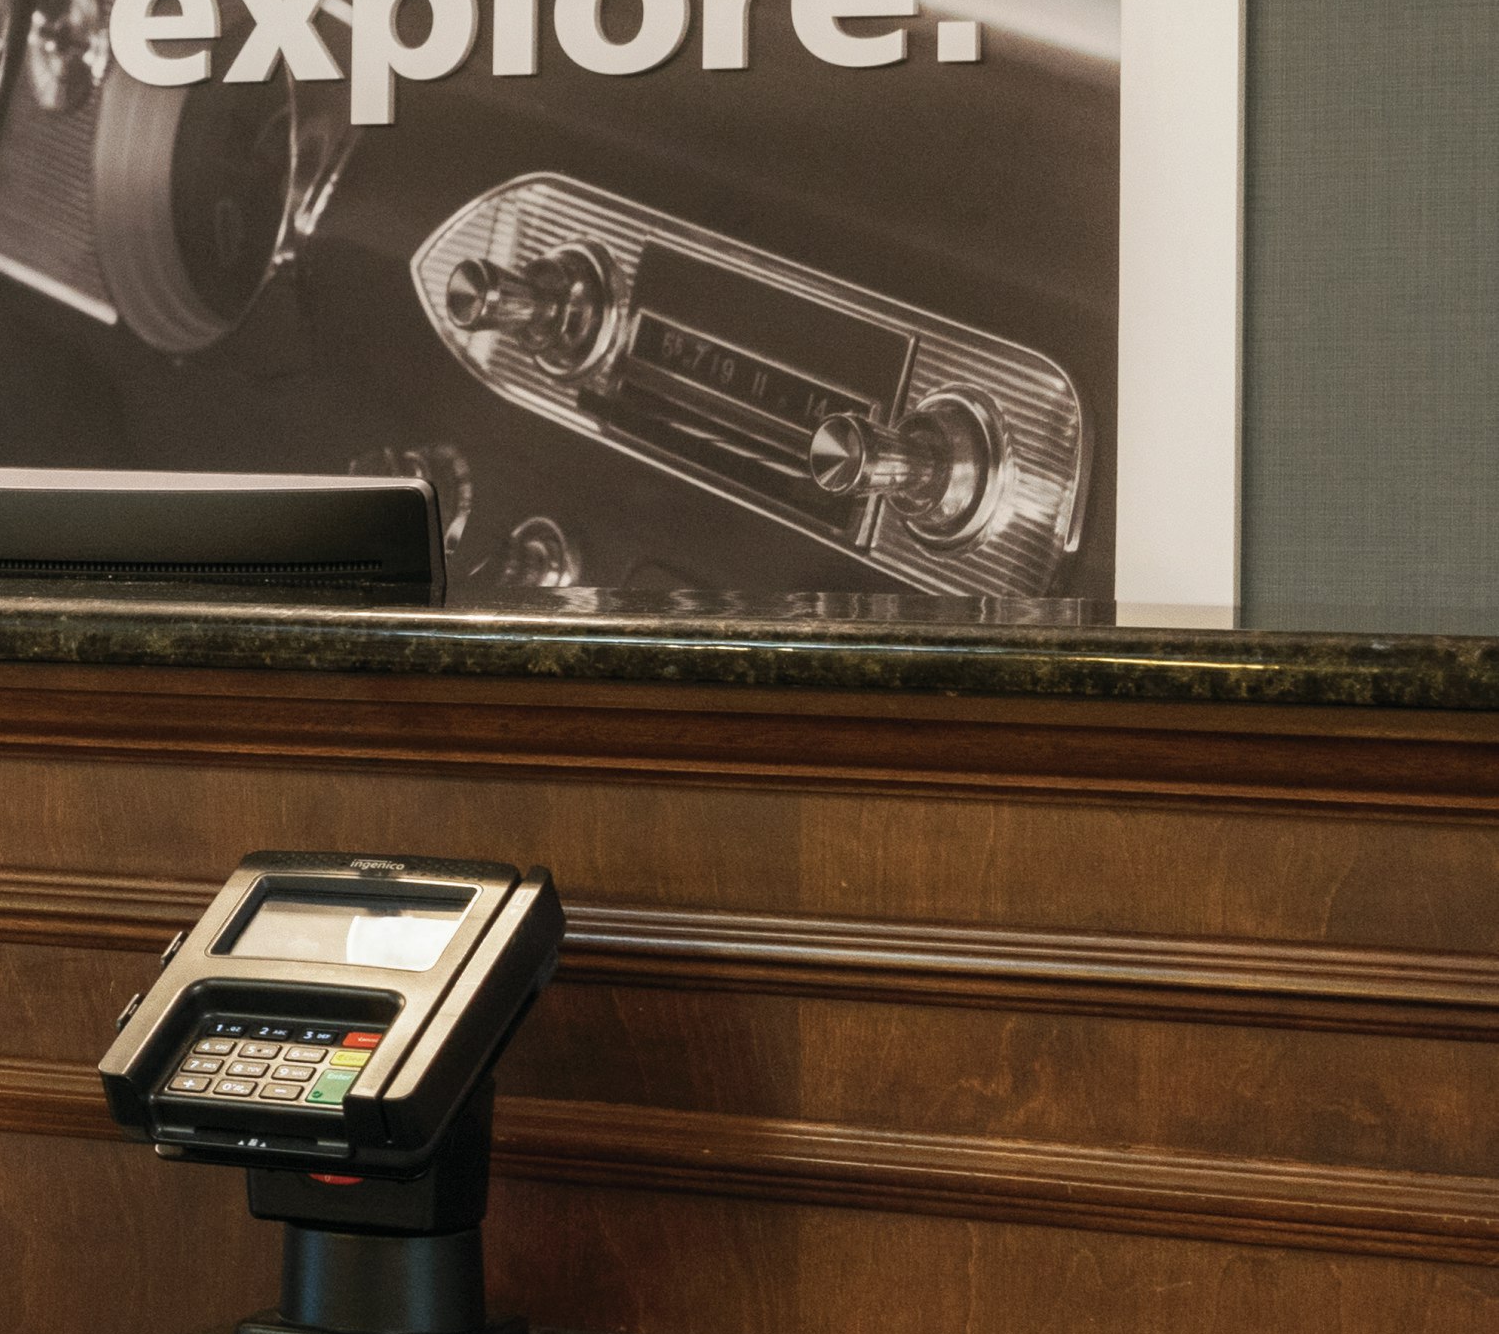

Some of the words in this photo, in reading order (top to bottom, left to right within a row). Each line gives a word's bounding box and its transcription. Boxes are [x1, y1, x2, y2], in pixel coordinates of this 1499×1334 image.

[350, 859, 405, 870] ingenico
[216, 1024, 223, 1032] 1
[259, 1027, 269, 1035] 2
[303, 1031, 314, 1039] 3
[202, 1042, 210, 1050] 4
[247, 1046, 256, 1054] 5
[190, 1060, 199, 1068] 7
[233, 1064, 244, 1072] 8
